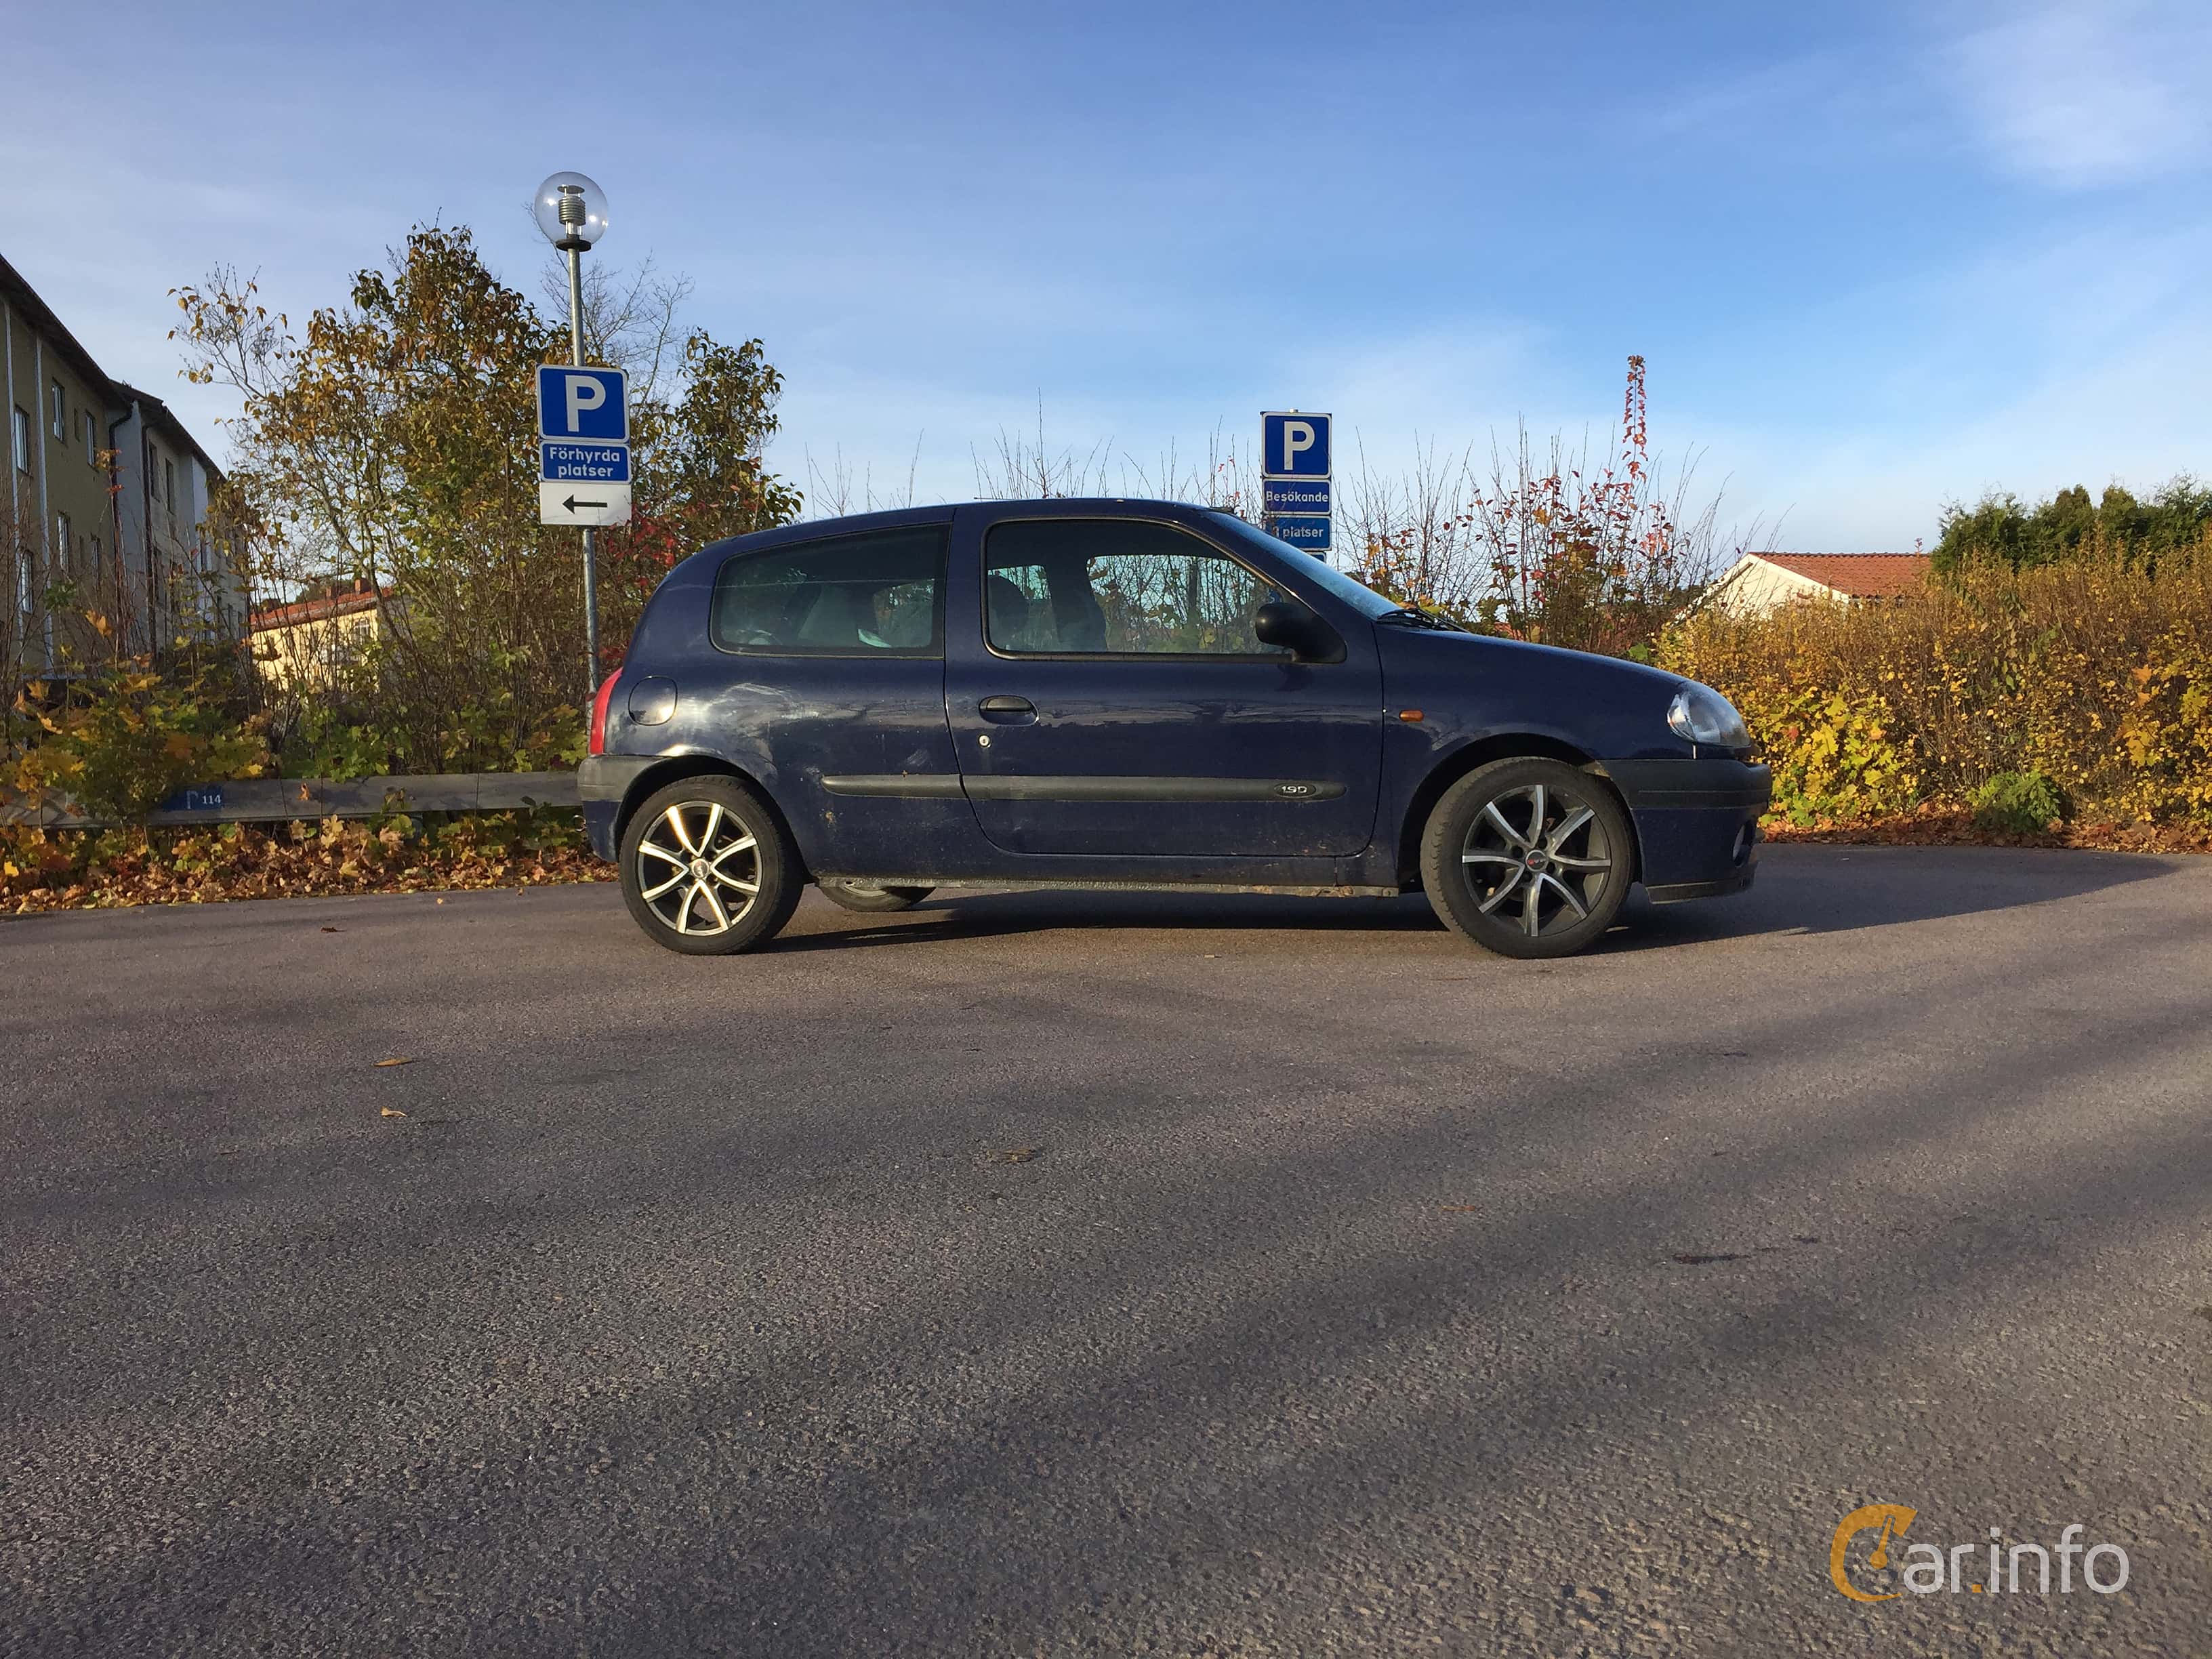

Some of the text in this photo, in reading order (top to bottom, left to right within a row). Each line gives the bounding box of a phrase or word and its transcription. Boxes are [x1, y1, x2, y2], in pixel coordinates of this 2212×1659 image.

[565, 374, 607, 432] P
[1284, 421, 1315, 470] P
[549, 447, 620, 464] Förhyrda
[558, 464, 613, 478] platser
[1266, 491, 1329, 502] Besökande
[1282, 526, 1324, 539] platser
[202, 794, 222, 804] 114
